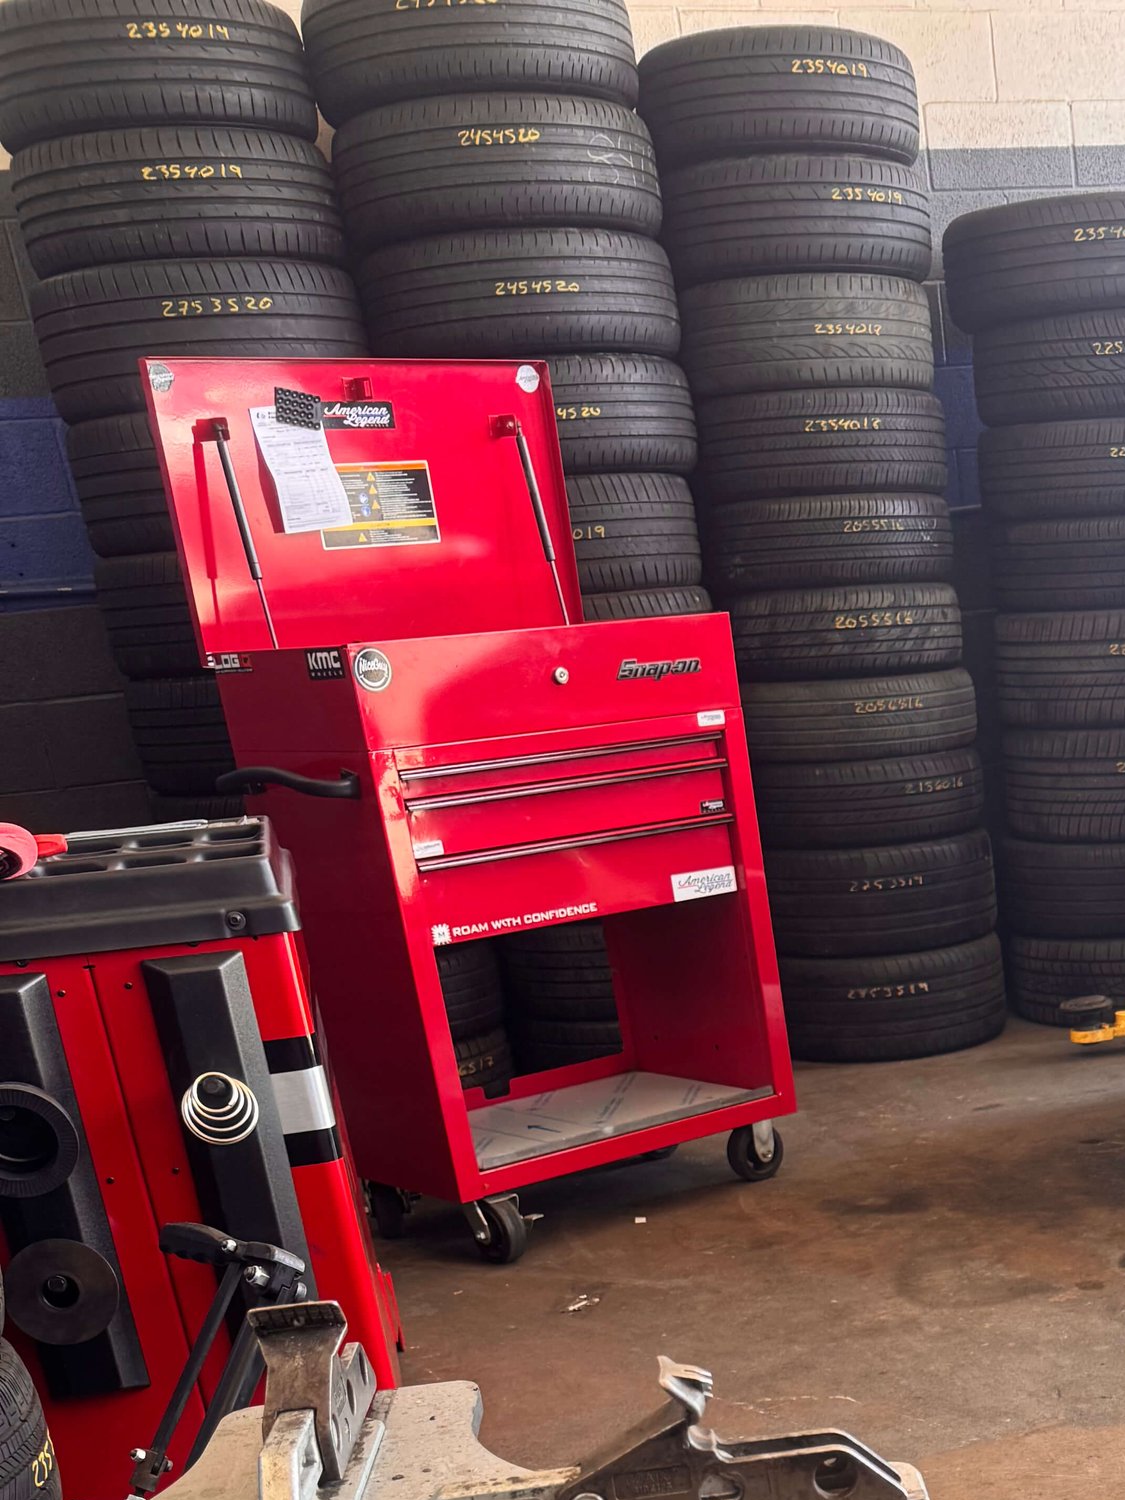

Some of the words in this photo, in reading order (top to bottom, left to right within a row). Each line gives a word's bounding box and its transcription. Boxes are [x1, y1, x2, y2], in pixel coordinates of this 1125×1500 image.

[791, 59, 867, 78] 2354019
[458, 128, 540, 146] 2454520
[141, 164, 243, 180] 2354019
[831, 187, 902, 204] 2354019
[495, 280, 579, 295] 2454520
[162, 297, 273, 317] 2753520
[324, 402, 389, 416] American
[307, 651, 340, 669] KMC
[452, 922, 489, 937] ROAM
[523, 902, 598, 924] CONFIDENCE
